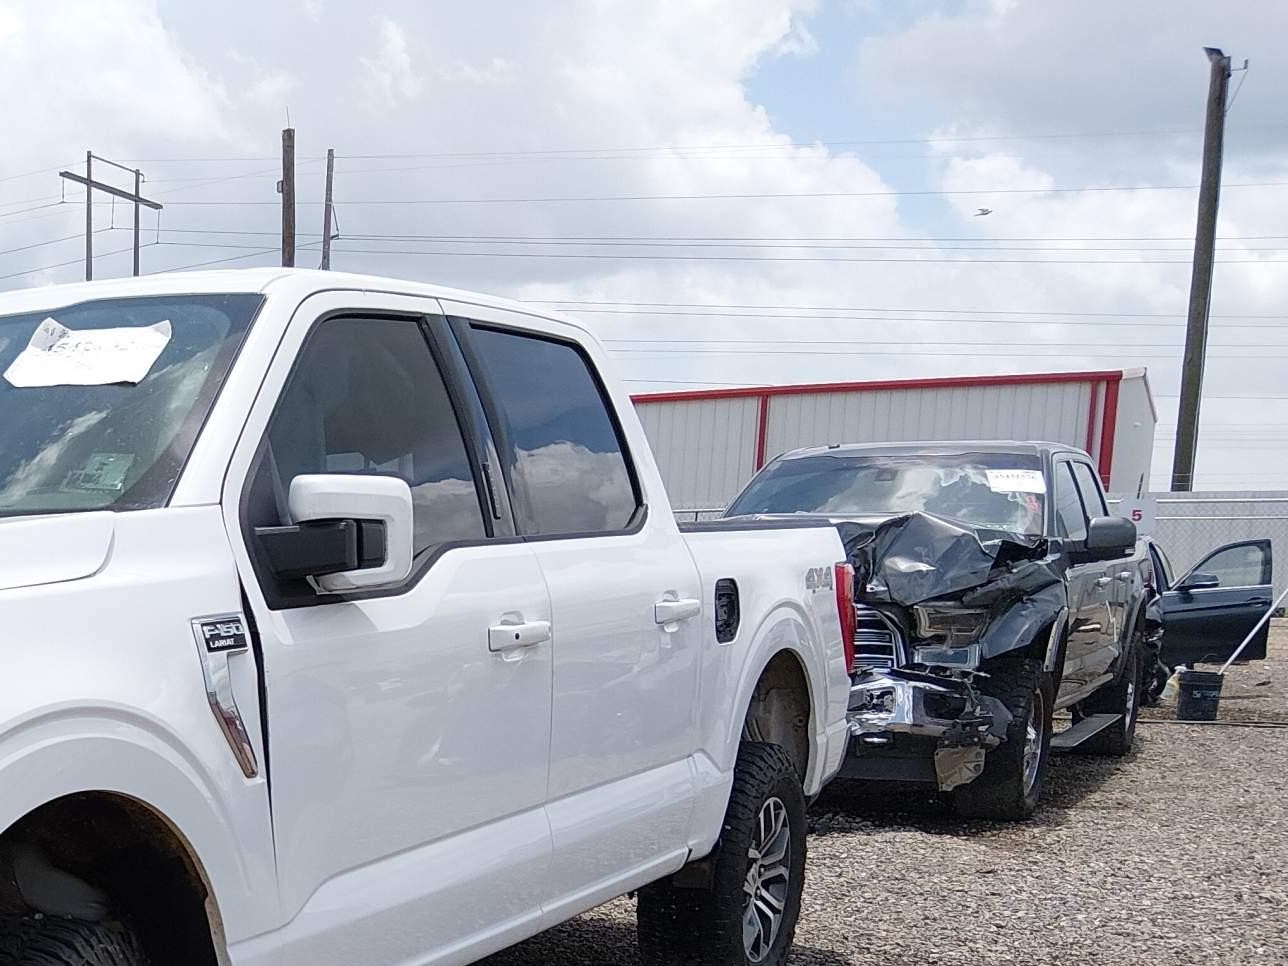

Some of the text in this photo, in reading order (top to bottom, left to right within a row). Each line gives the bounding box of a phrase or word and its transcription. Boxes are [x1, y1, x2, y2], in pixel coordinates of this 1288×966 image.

[1132, 509, 1143, 522] 5
[202, 622, 245, 639] F-150
[209, 638, 235, 649] LARIAT
